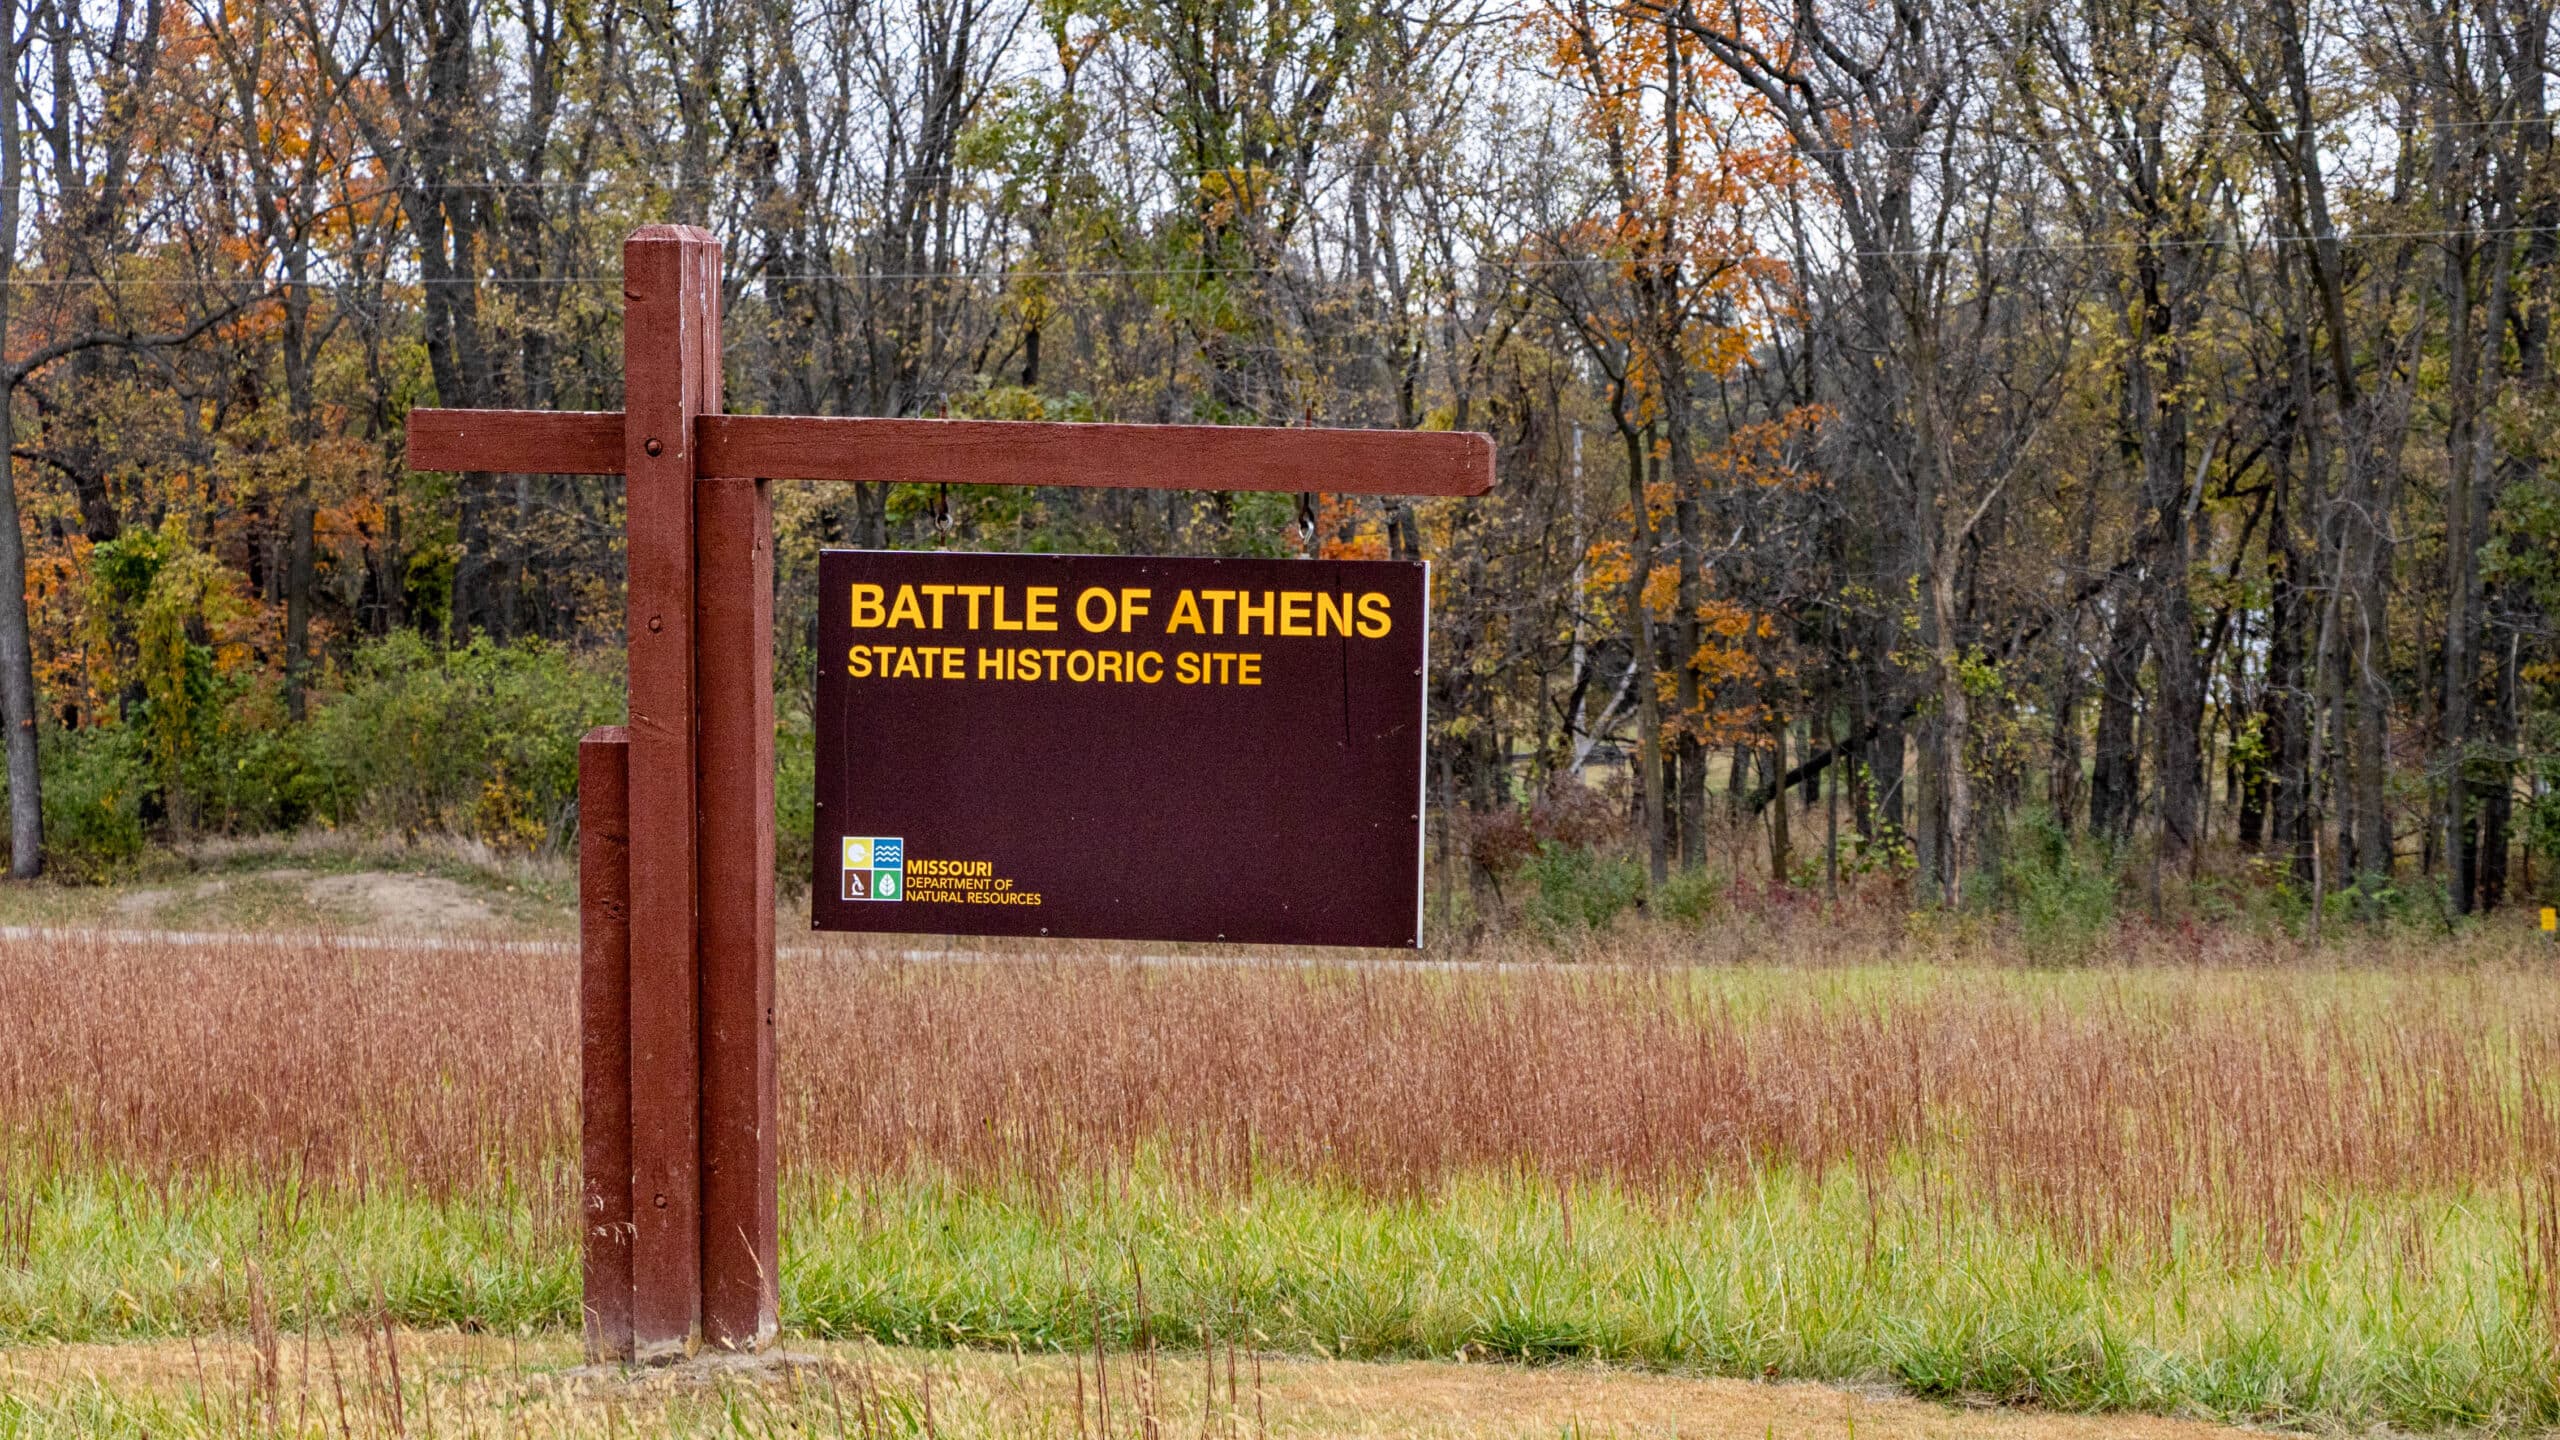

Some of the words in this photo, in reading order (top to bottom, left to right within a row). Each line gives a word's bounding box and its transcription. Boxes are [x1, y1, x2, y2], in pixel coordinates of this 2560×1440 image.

[851, 583, 1059, 632] BATTLE
[1076, 587, 1152, 634] OF
[1166, 589, 1392, 638] ATHENS
[848, 645, 966, 679] STATE
[978, 648, 1164, 684] HISTORIC
[1176, 651, 1262, 686] SITE
[906, 860, 993, 877] MISSOURI
[906, 876, 991, 890] DEPARTMENT
[994, 879, 1014, 891] OF
[906, 890, 964, 904] NATURAL
[967, 892, 1042, 906] RESOURCES
